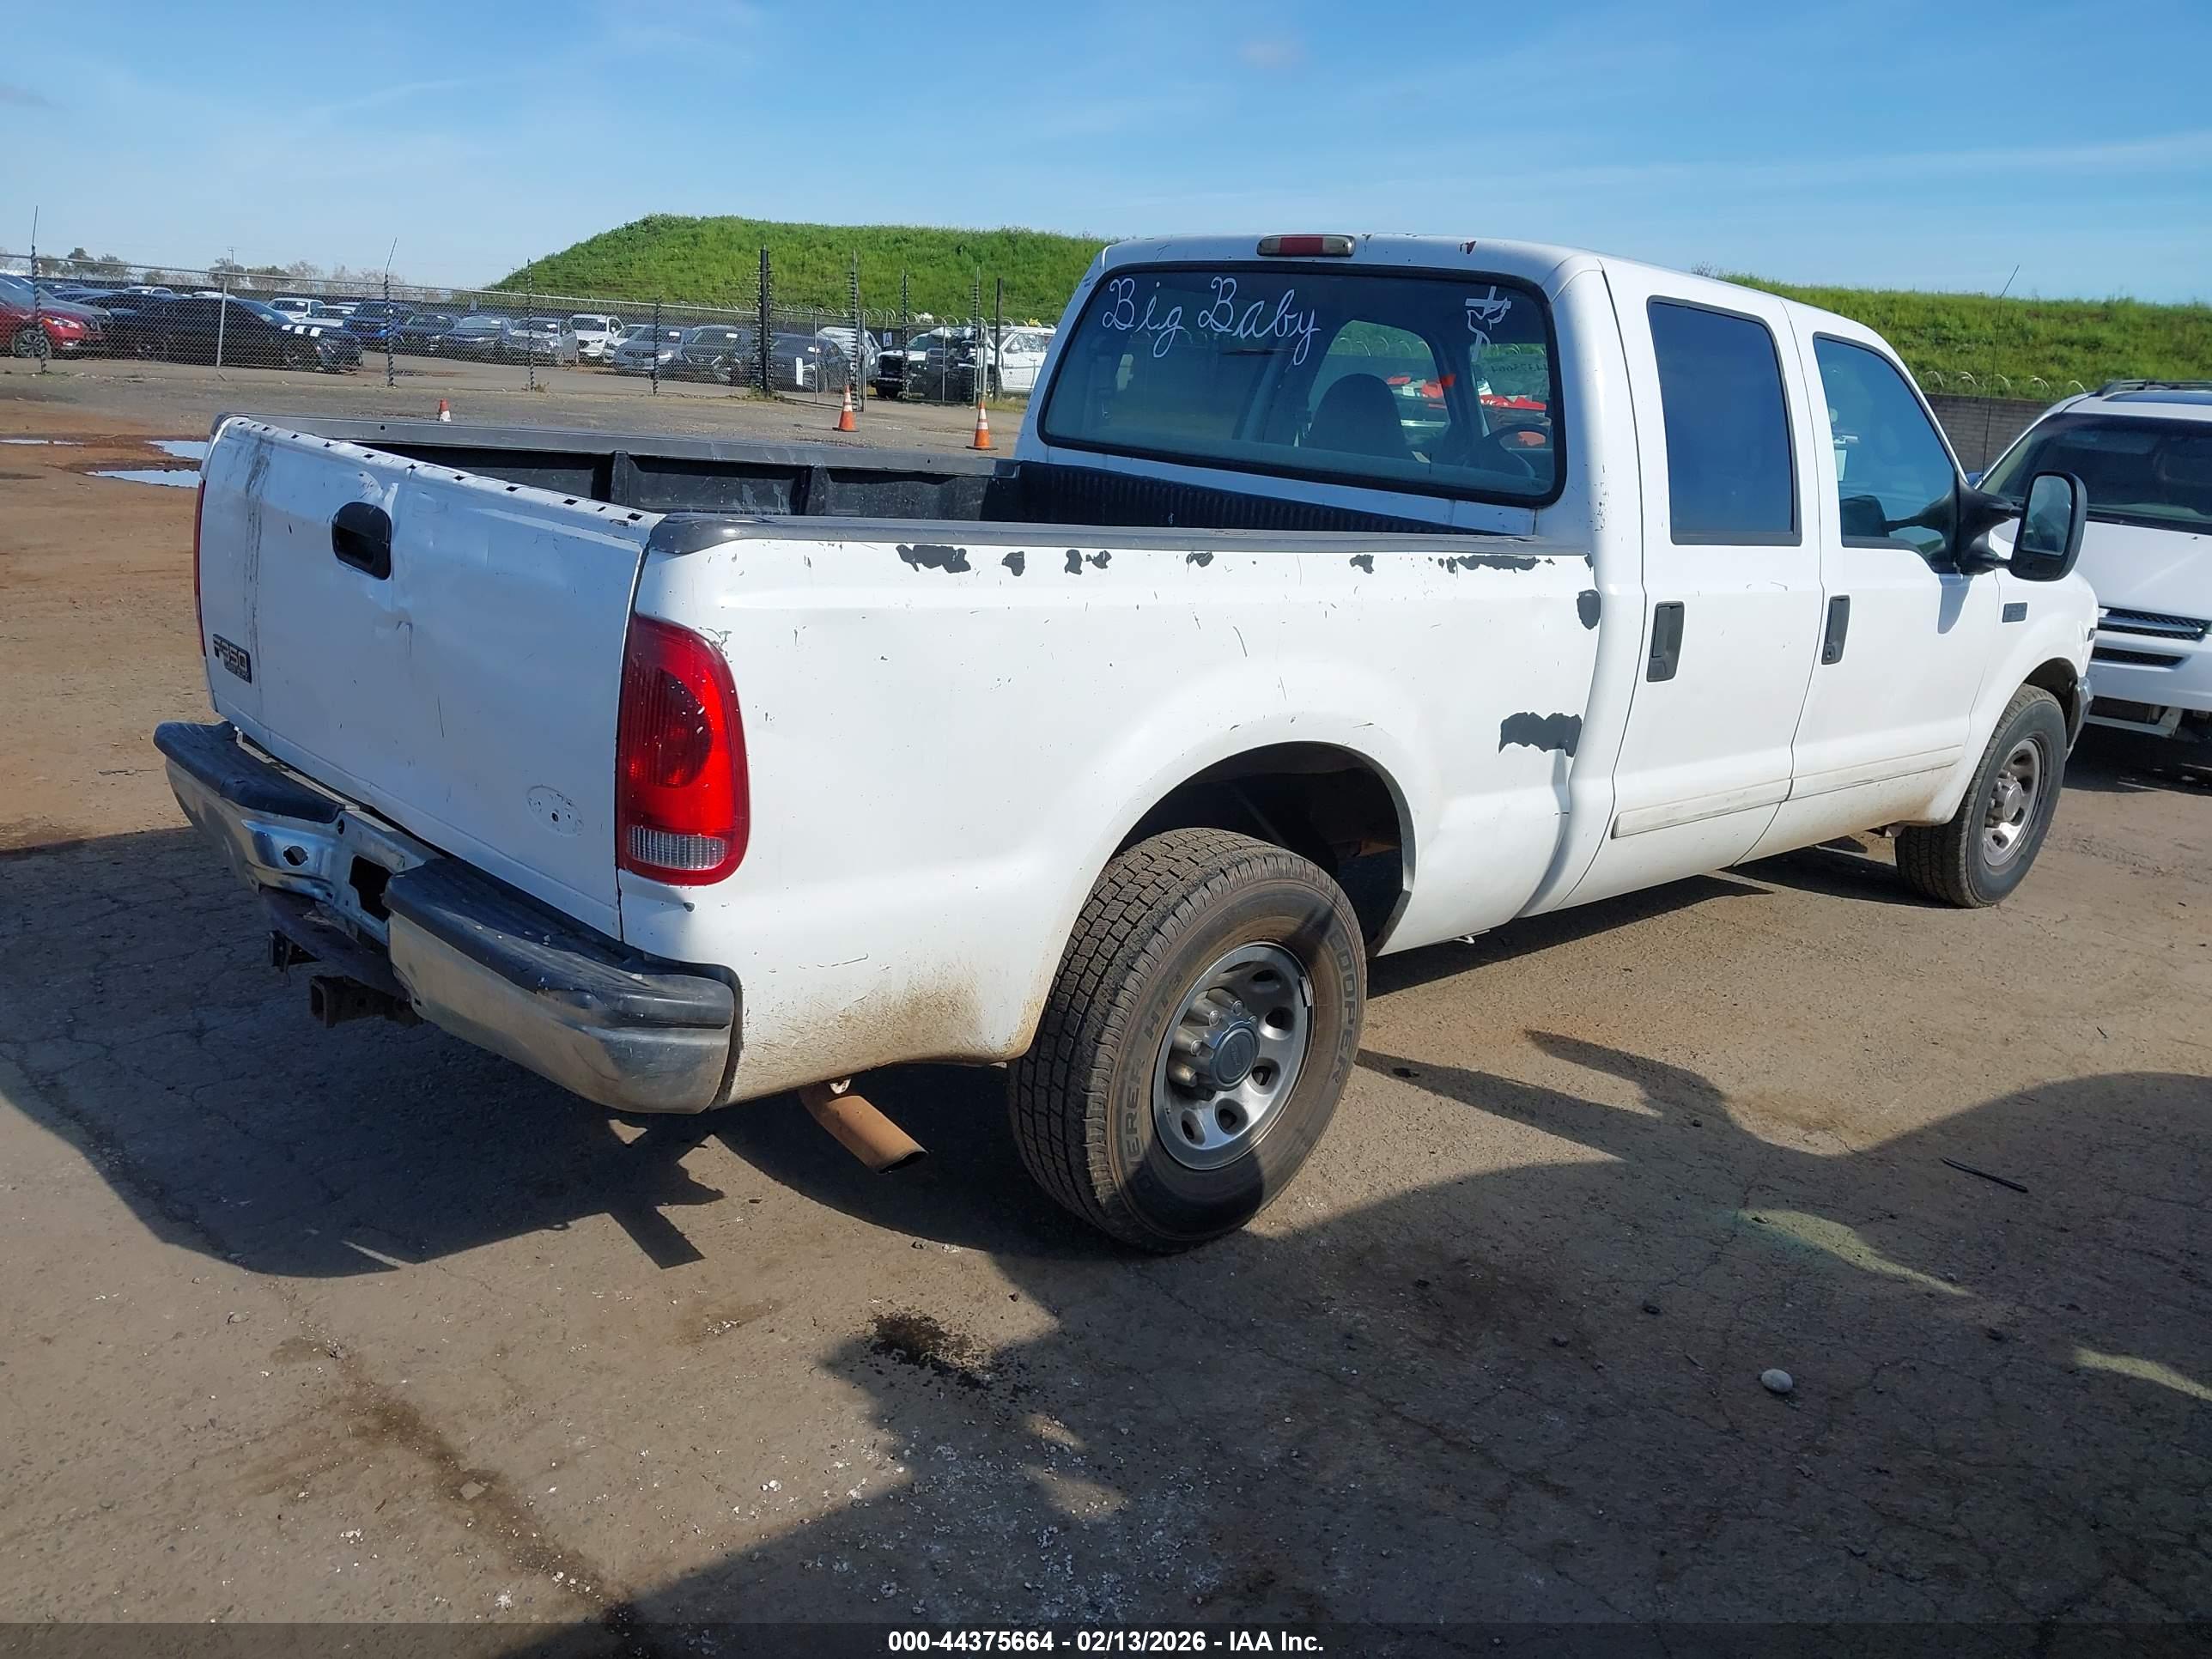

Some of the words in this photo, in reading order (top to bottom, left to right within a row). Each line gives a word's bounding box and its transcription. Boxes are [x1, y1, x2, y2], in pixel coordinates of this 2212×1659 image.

[884, 333, 891, 346] A
[1102, 277, 1187, 359] Big
[1197, 276, 1323, 367] Baby
[1328, 928, 1356, 1085] COOPER
